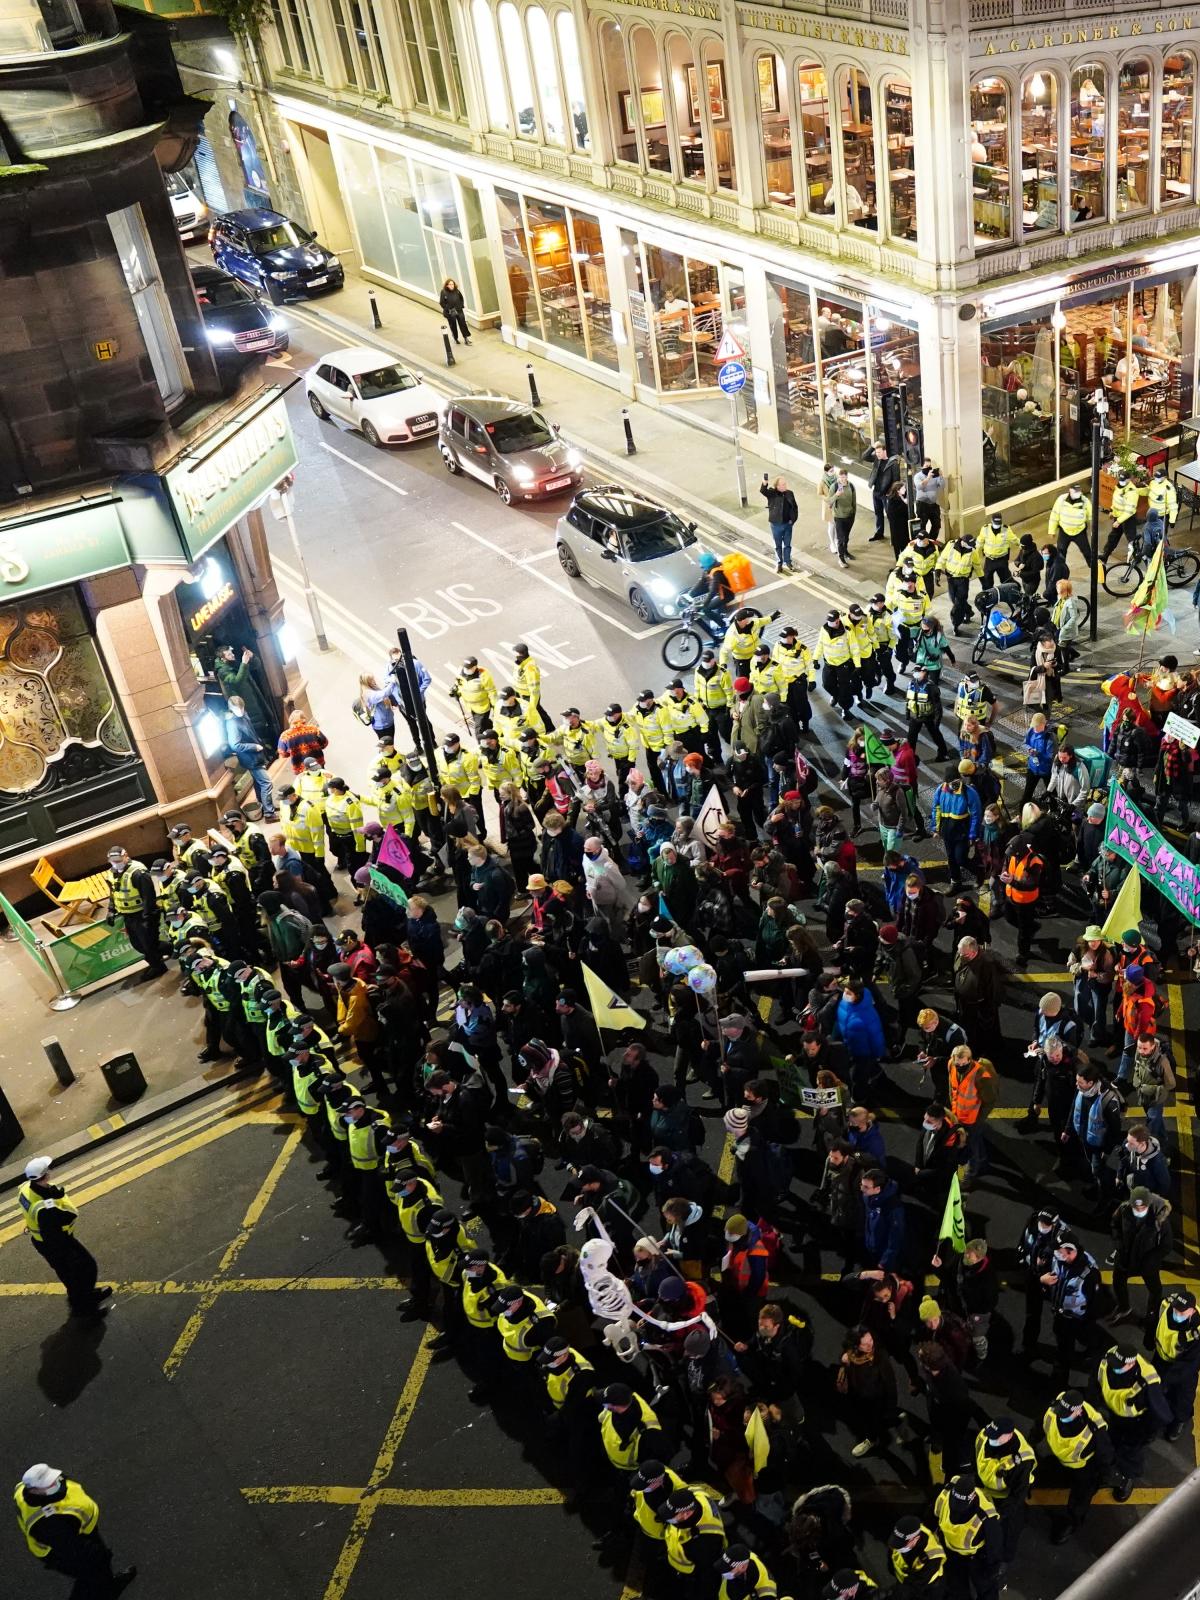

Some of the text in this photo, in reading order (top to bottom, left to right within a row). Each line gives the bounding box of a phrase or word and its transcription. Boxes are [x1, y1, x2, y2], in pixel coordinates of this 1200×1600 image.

[688, 5, 717, 19] SON
[750, 15, 907, 55] UPHOLSTERERS
[1010, 26, 1120, 51] GARDNER
[1131, 23, 1142, 36] &
[1155, 16, 1193, 33] SON
[97, 344, 112, 359] H
[388, 583, 503, 640] BUS
[443, 624, 597, 686] ANE
[1112, 789, 1156, 842] HOW
[1107, 826, 1166, 883] ARREST
[100, 941, 133, 963] Hein
[954, 1492, 967, 1501] POLICE
